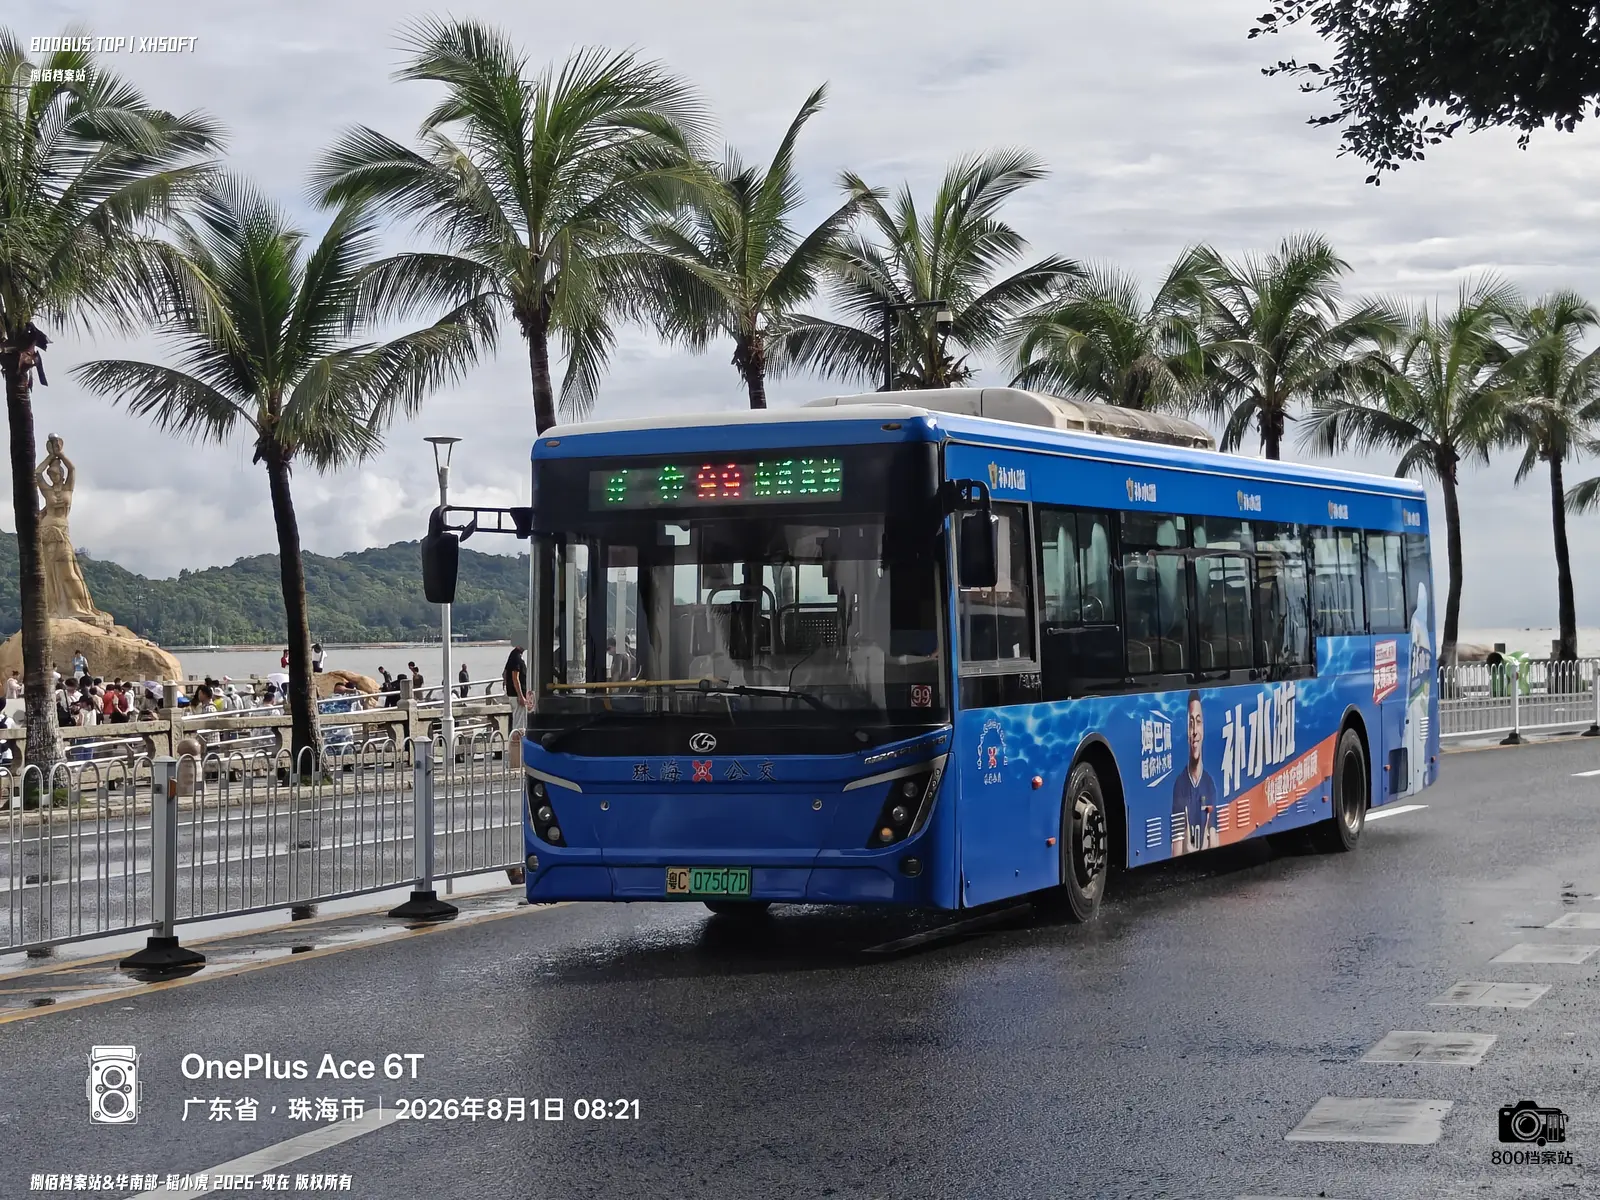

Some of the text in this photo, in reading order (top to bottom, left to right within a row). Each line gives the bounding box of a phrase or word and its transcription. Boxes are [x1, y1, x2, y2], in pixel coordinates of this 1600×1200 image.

[912, 687, 931, 705] 99
[1220, 680, 1296, 798] 补水啦
